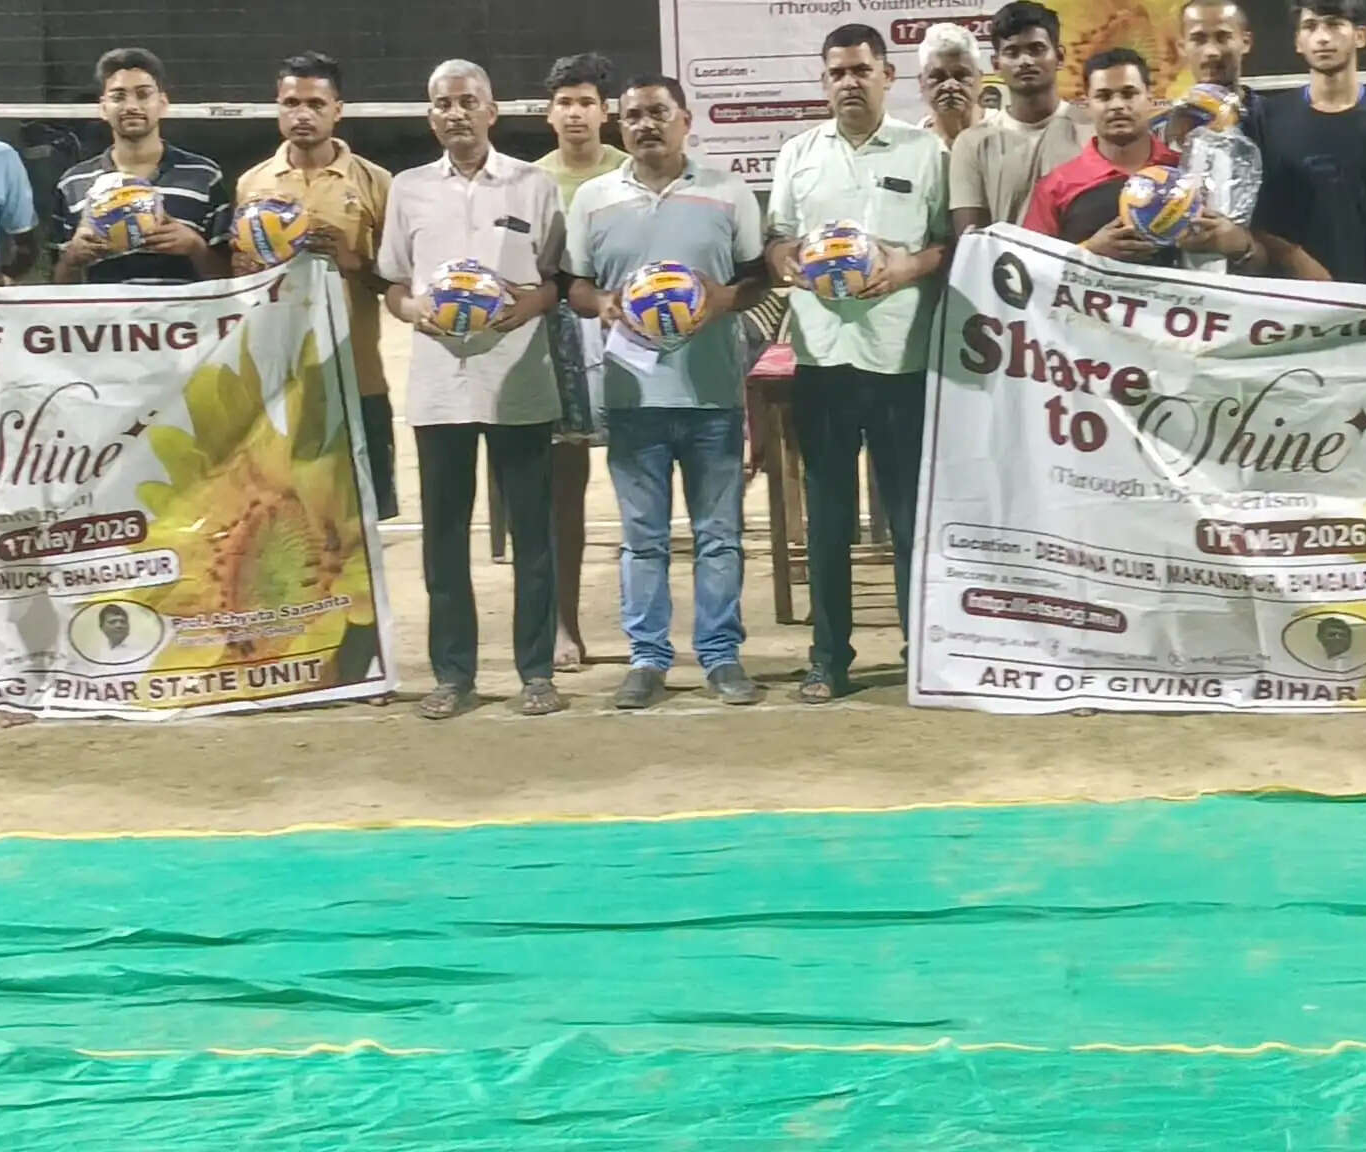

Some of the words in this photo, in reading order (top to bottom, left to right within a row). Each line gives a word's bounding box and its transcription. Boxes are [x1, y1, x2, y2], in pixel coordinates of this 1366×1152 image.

[974, 20, 993, 36] 20
[730, 158, 773, 174] ART
[1051, 284, 1148, 328] ART
[1165, 306, 1232, 342] OF
[23, 321, 198, 355] GIVING
[959, 313, 1151, 406] Share
[1044, 395, 1108, 452] to
[1134, 368, 1349, 479] Shine
[81, 517, 140, 544] 2026
[1245, 528, 1299, 555] May
[1303, 524, 1366, 548] 2026
[63, 555, 173, 587] BHAGALPUR
[949, 534, 1021, 553] Location
[1112, 557, 1161, 585] CLUB,
[54, 678, 137, 701] BIHAR
[149, 672, 237, 700] STATE
[247, 658, 322, 687] UNIT
[978, 666, 1043, 691] ART
[1054, 675, 1096, 692] OF
[1107, 676, 1223, 698] GIVING
[1254, 679, 1358, 701] BIHAR
